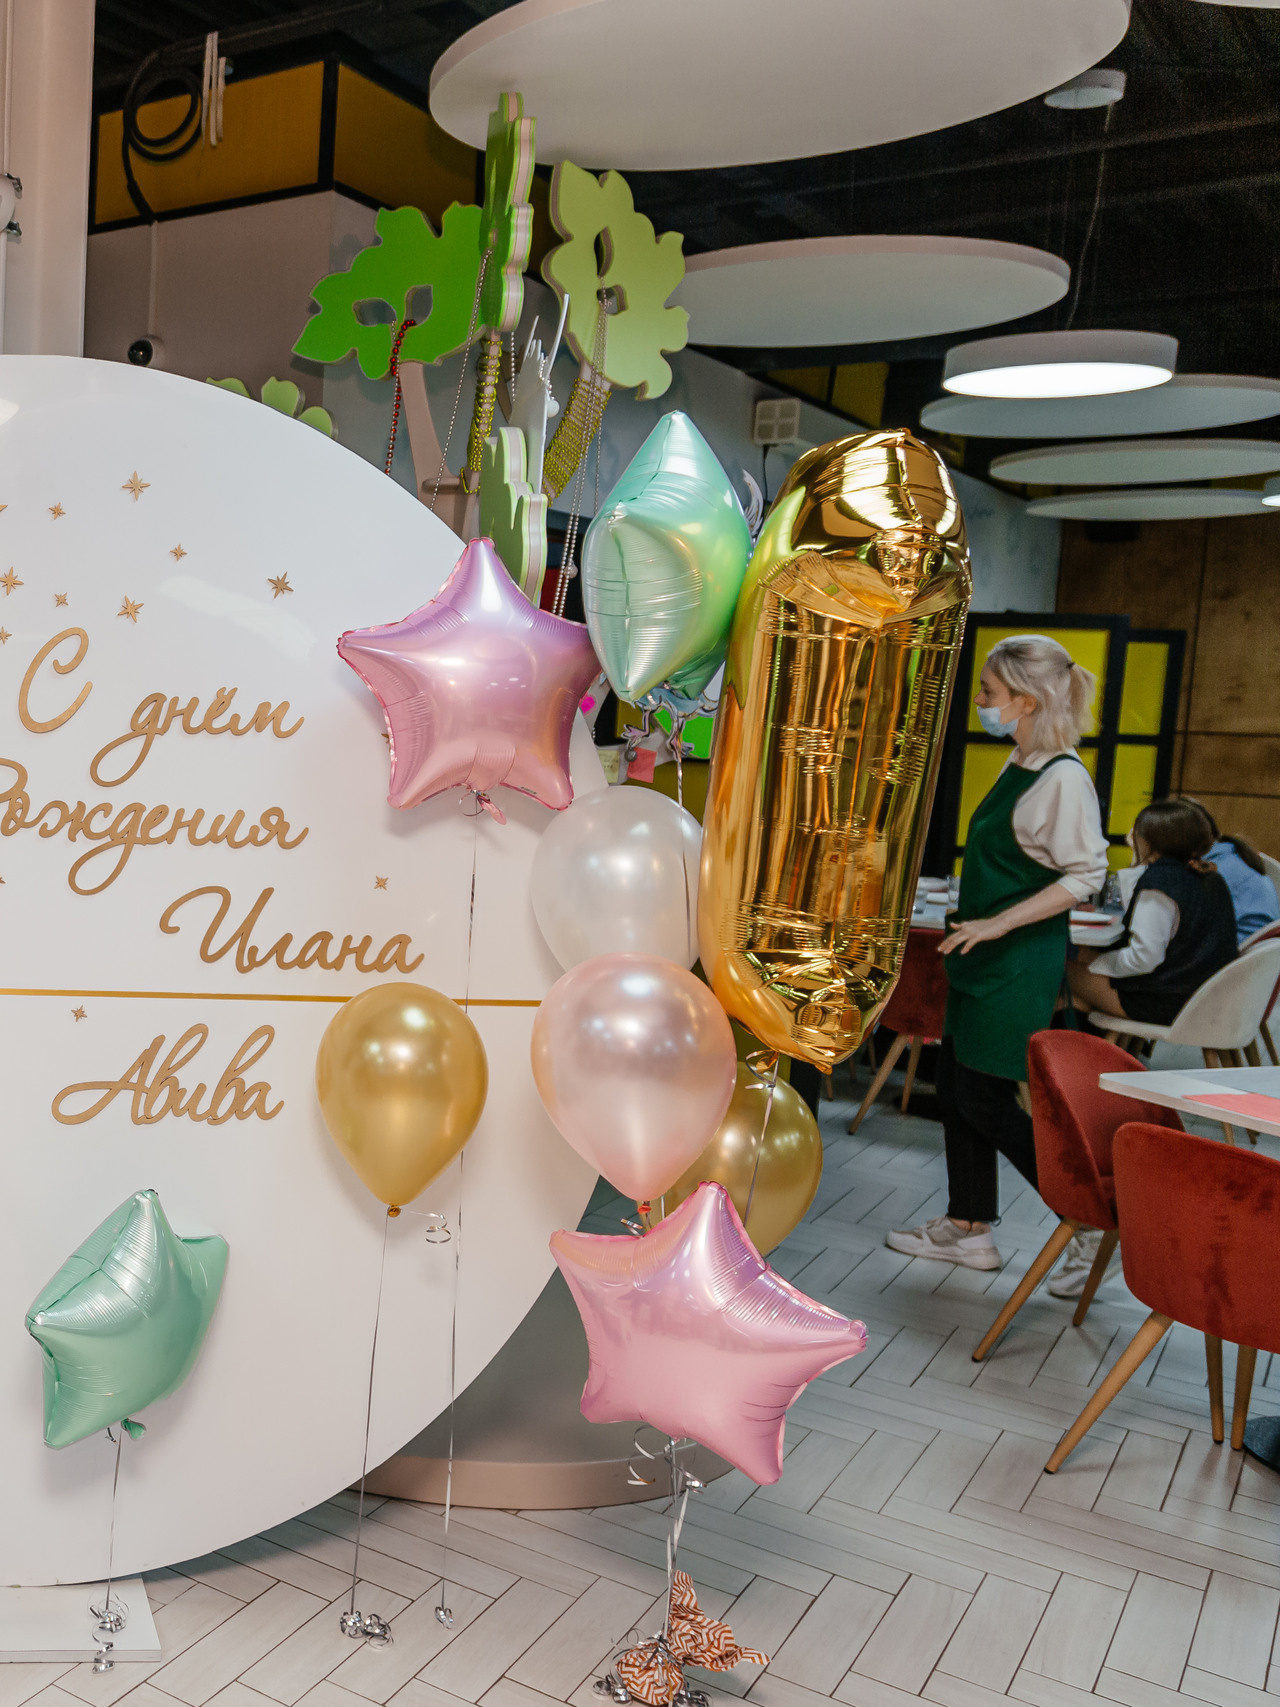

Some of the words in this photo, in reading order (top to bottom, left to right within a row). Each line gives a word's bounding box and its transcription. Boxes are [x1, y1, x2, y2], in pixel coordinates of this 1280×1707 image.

[18, 626, 93, 734] С
[89, 686, 305, 788] днём
[159, 885, 425, 974] Илана
[51, 1023, 285, 1126] Авива
